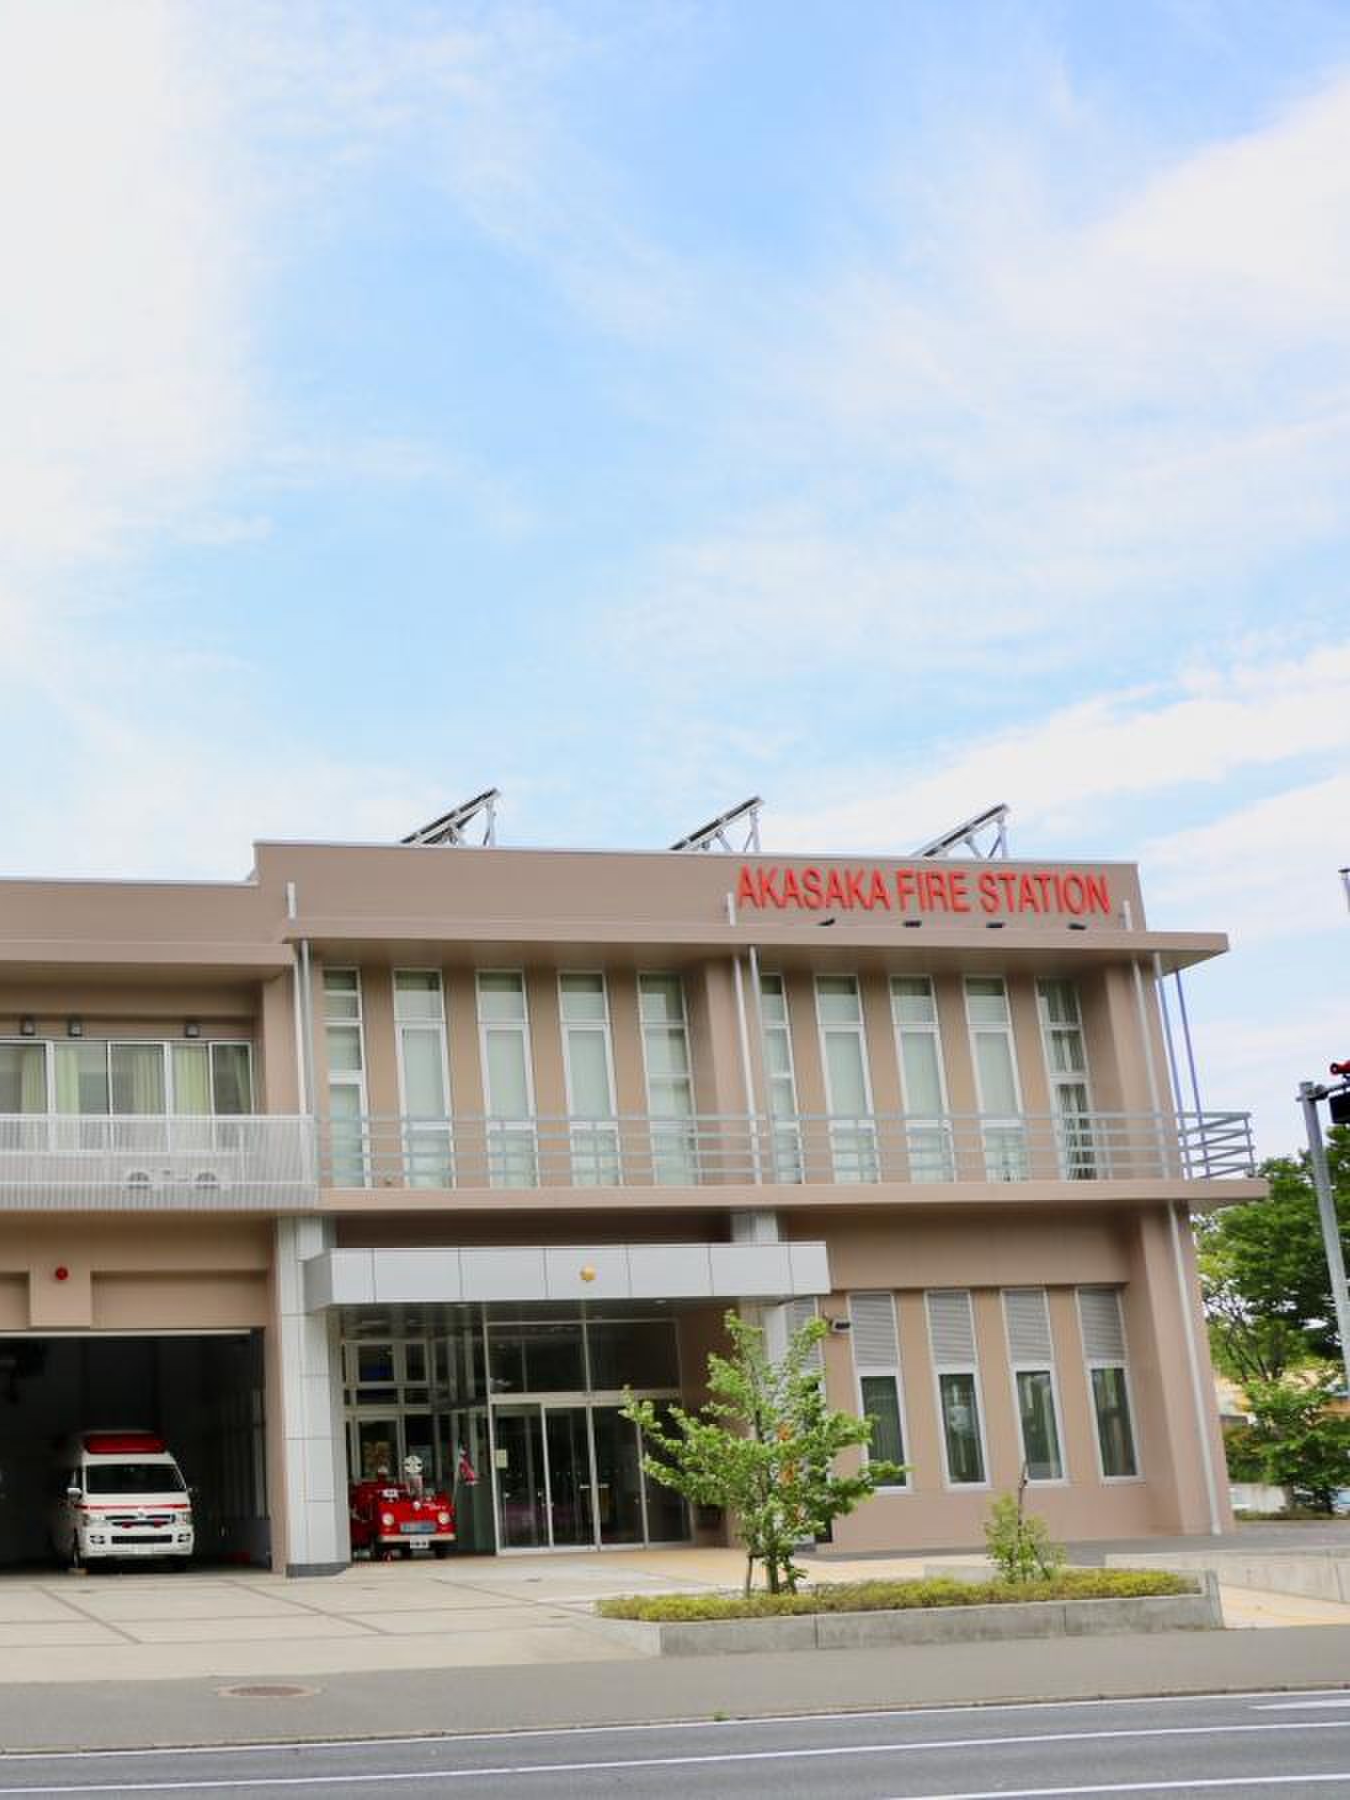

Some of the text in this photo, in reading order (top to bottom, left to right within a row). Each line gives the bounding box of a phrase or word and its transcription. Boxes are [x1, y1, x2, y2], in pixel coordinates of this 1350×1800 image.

[737, 864, 1111, 916] AKASAKA FIRE STATION
